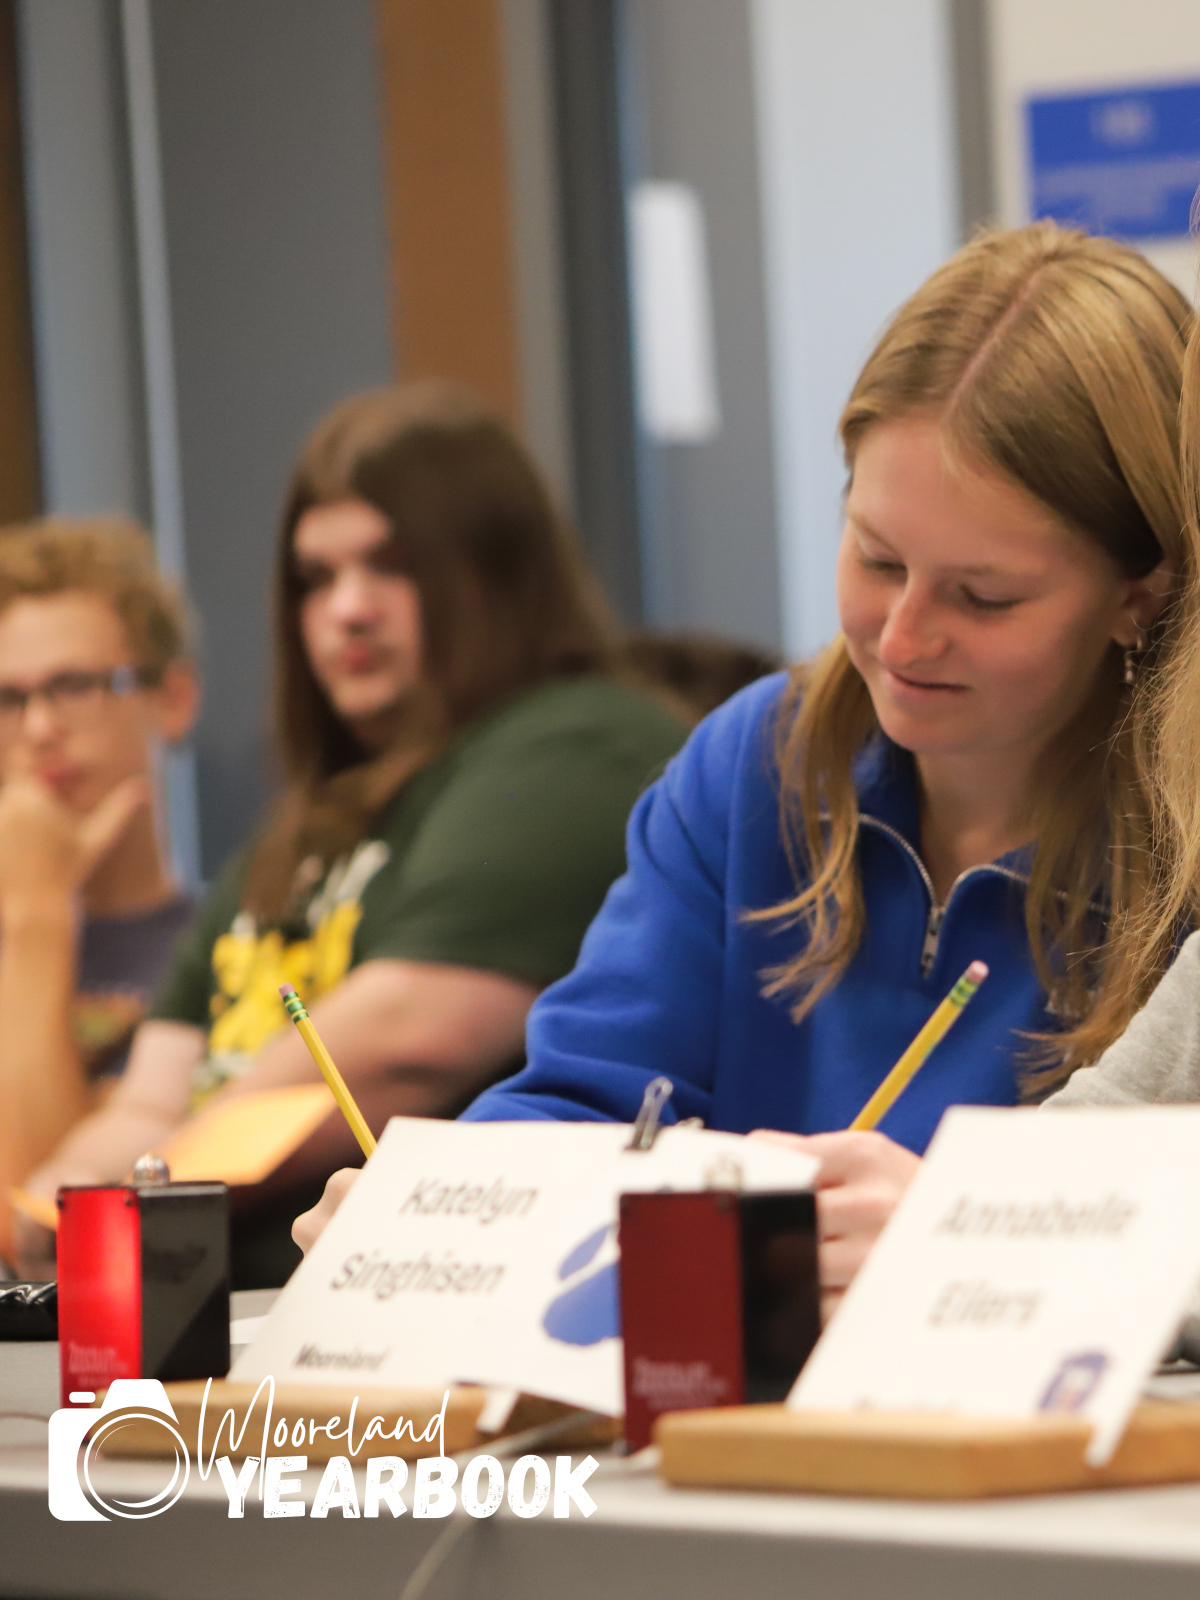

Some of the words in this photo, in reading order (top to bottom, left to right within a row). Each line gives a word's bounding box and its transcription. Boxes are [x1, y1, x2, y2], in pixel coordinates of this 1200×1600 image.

[400, 1177, 540, 1226] Katelyn
[932, 1192, 1140, 1238] Annabelle
[330, 1251, 506, 1301] Singhisen
[293, 1344, 392, 1371] Mooreland
